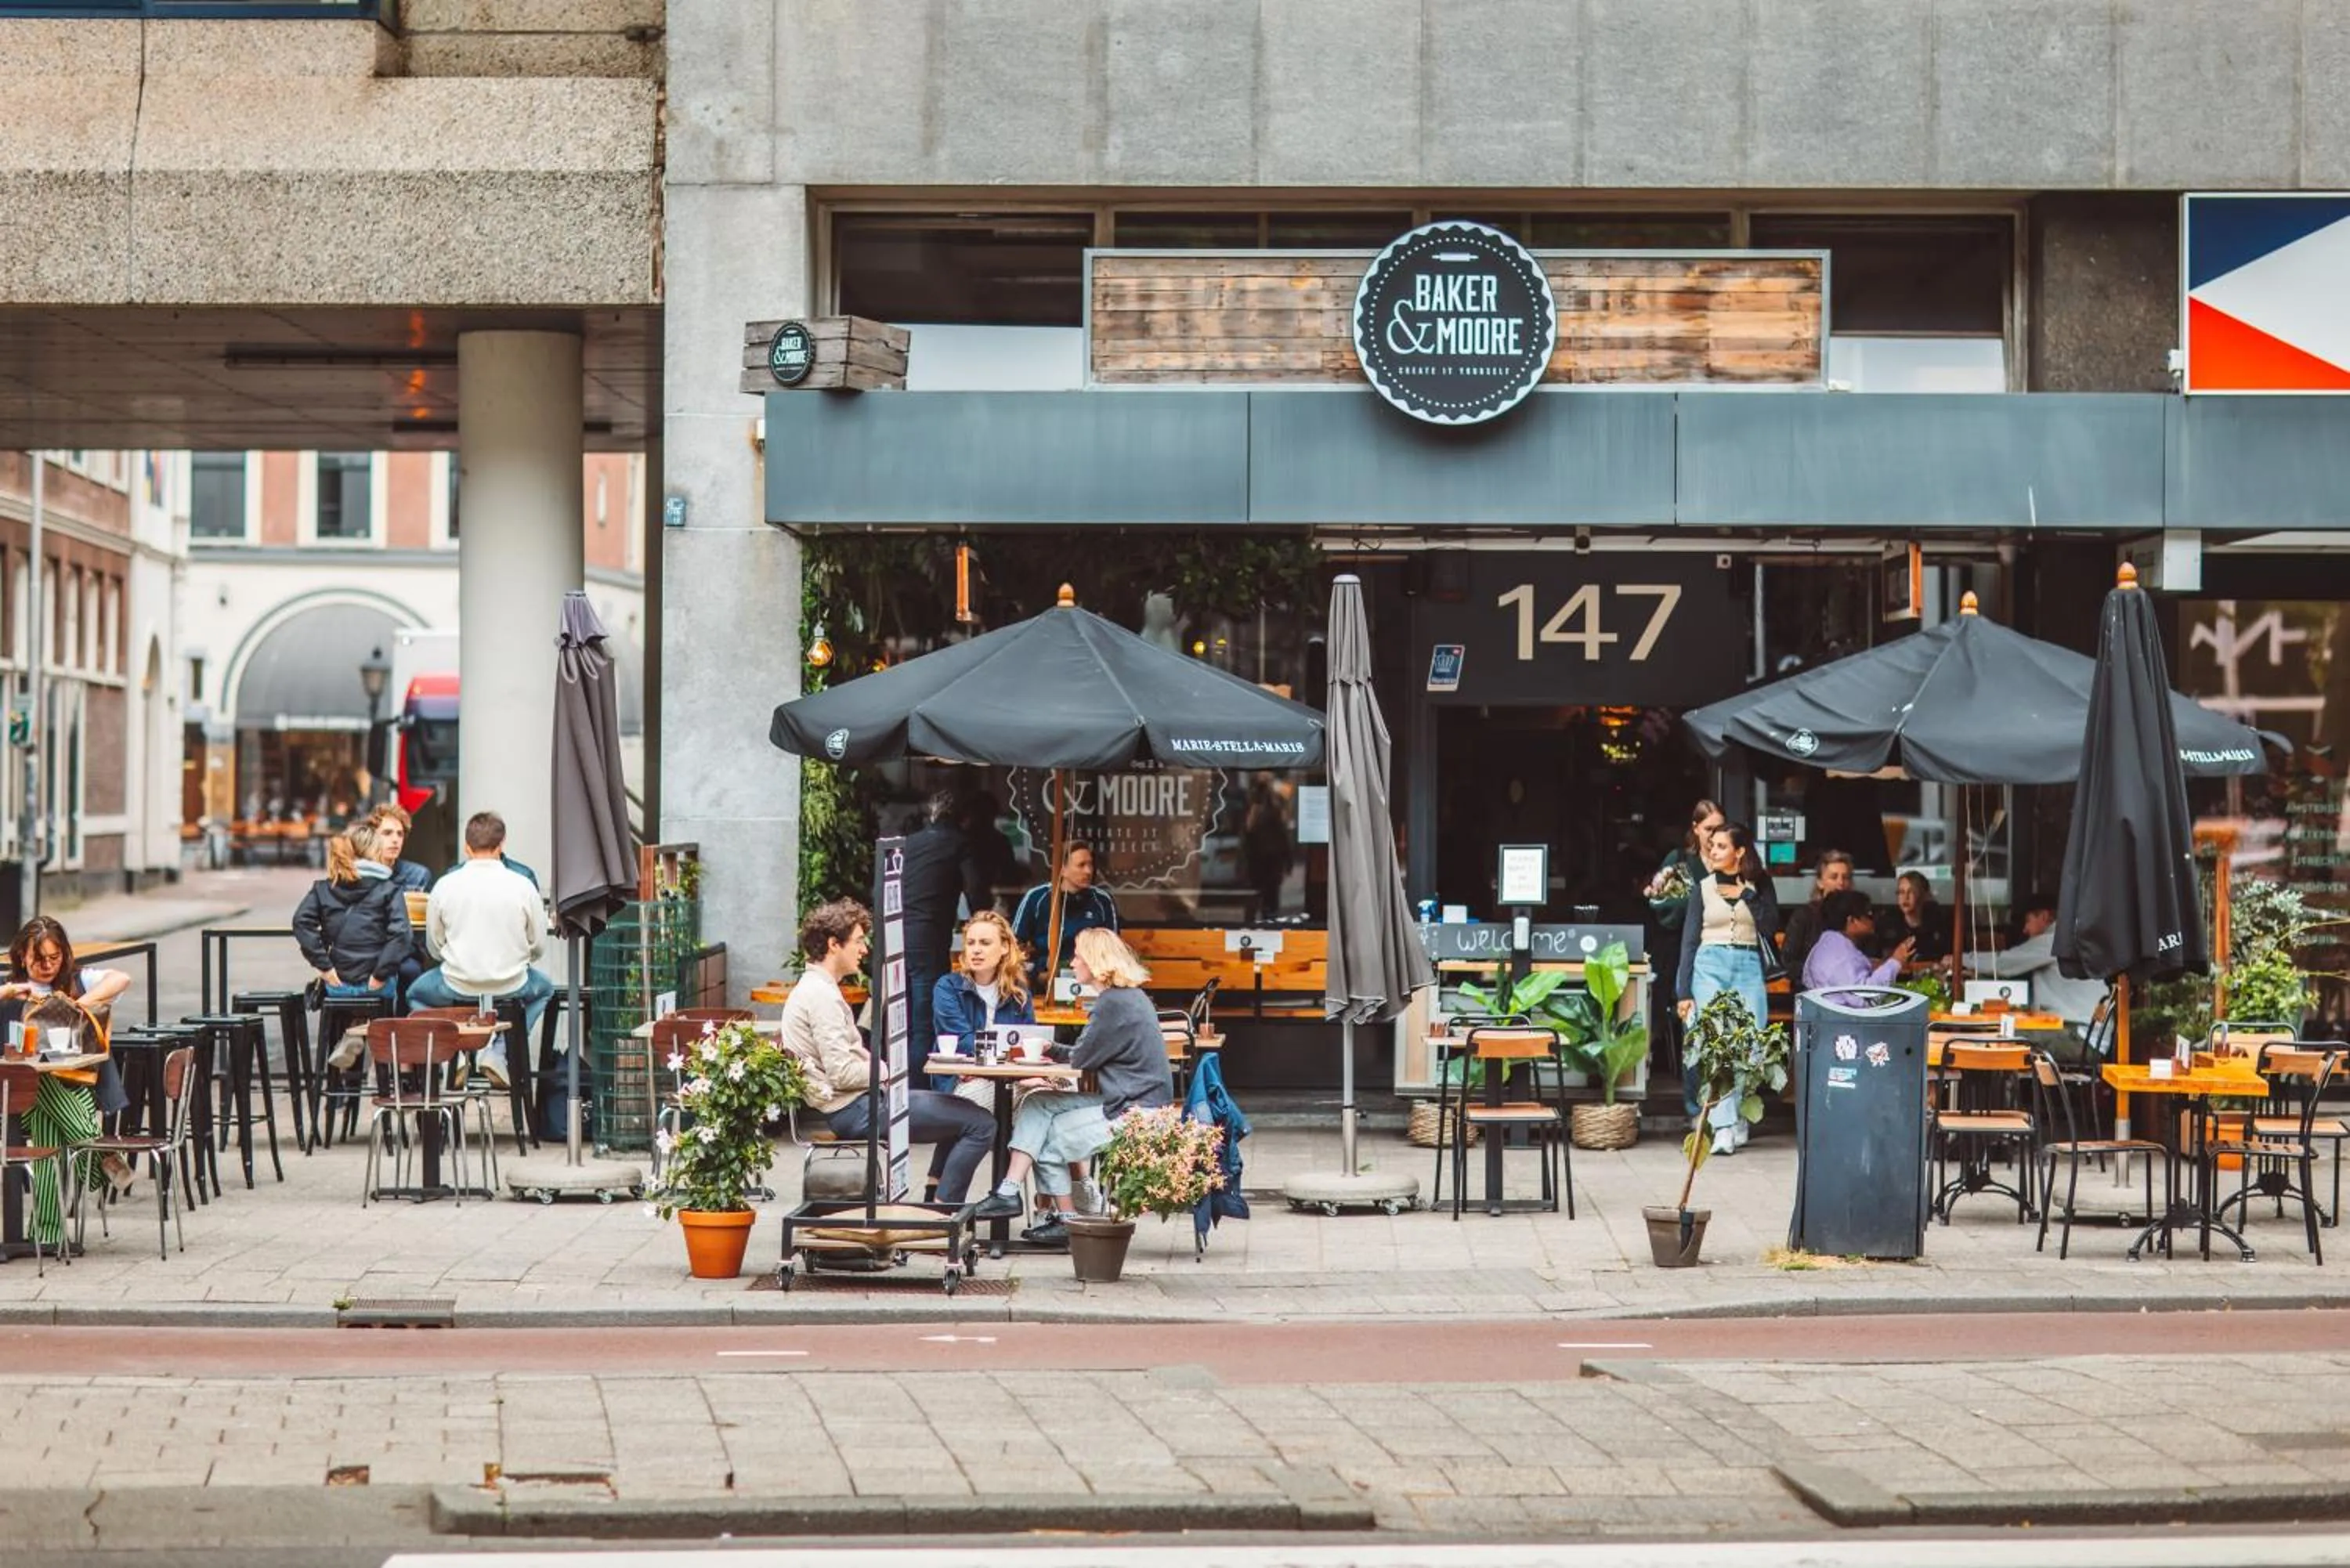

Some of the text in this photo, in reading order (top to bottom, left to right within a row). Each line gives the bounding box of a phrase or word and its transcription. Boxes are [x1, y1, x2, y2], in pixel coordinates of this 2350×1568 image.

[1415, 274, 1497, 312] BAKER
[1437, 317, 1524, 355] MOORE
[1498, 583, 1682, 660] 147
[1098, 775, 1194, 816] MOORE
[1456, 929, 1567, 952] welcme
